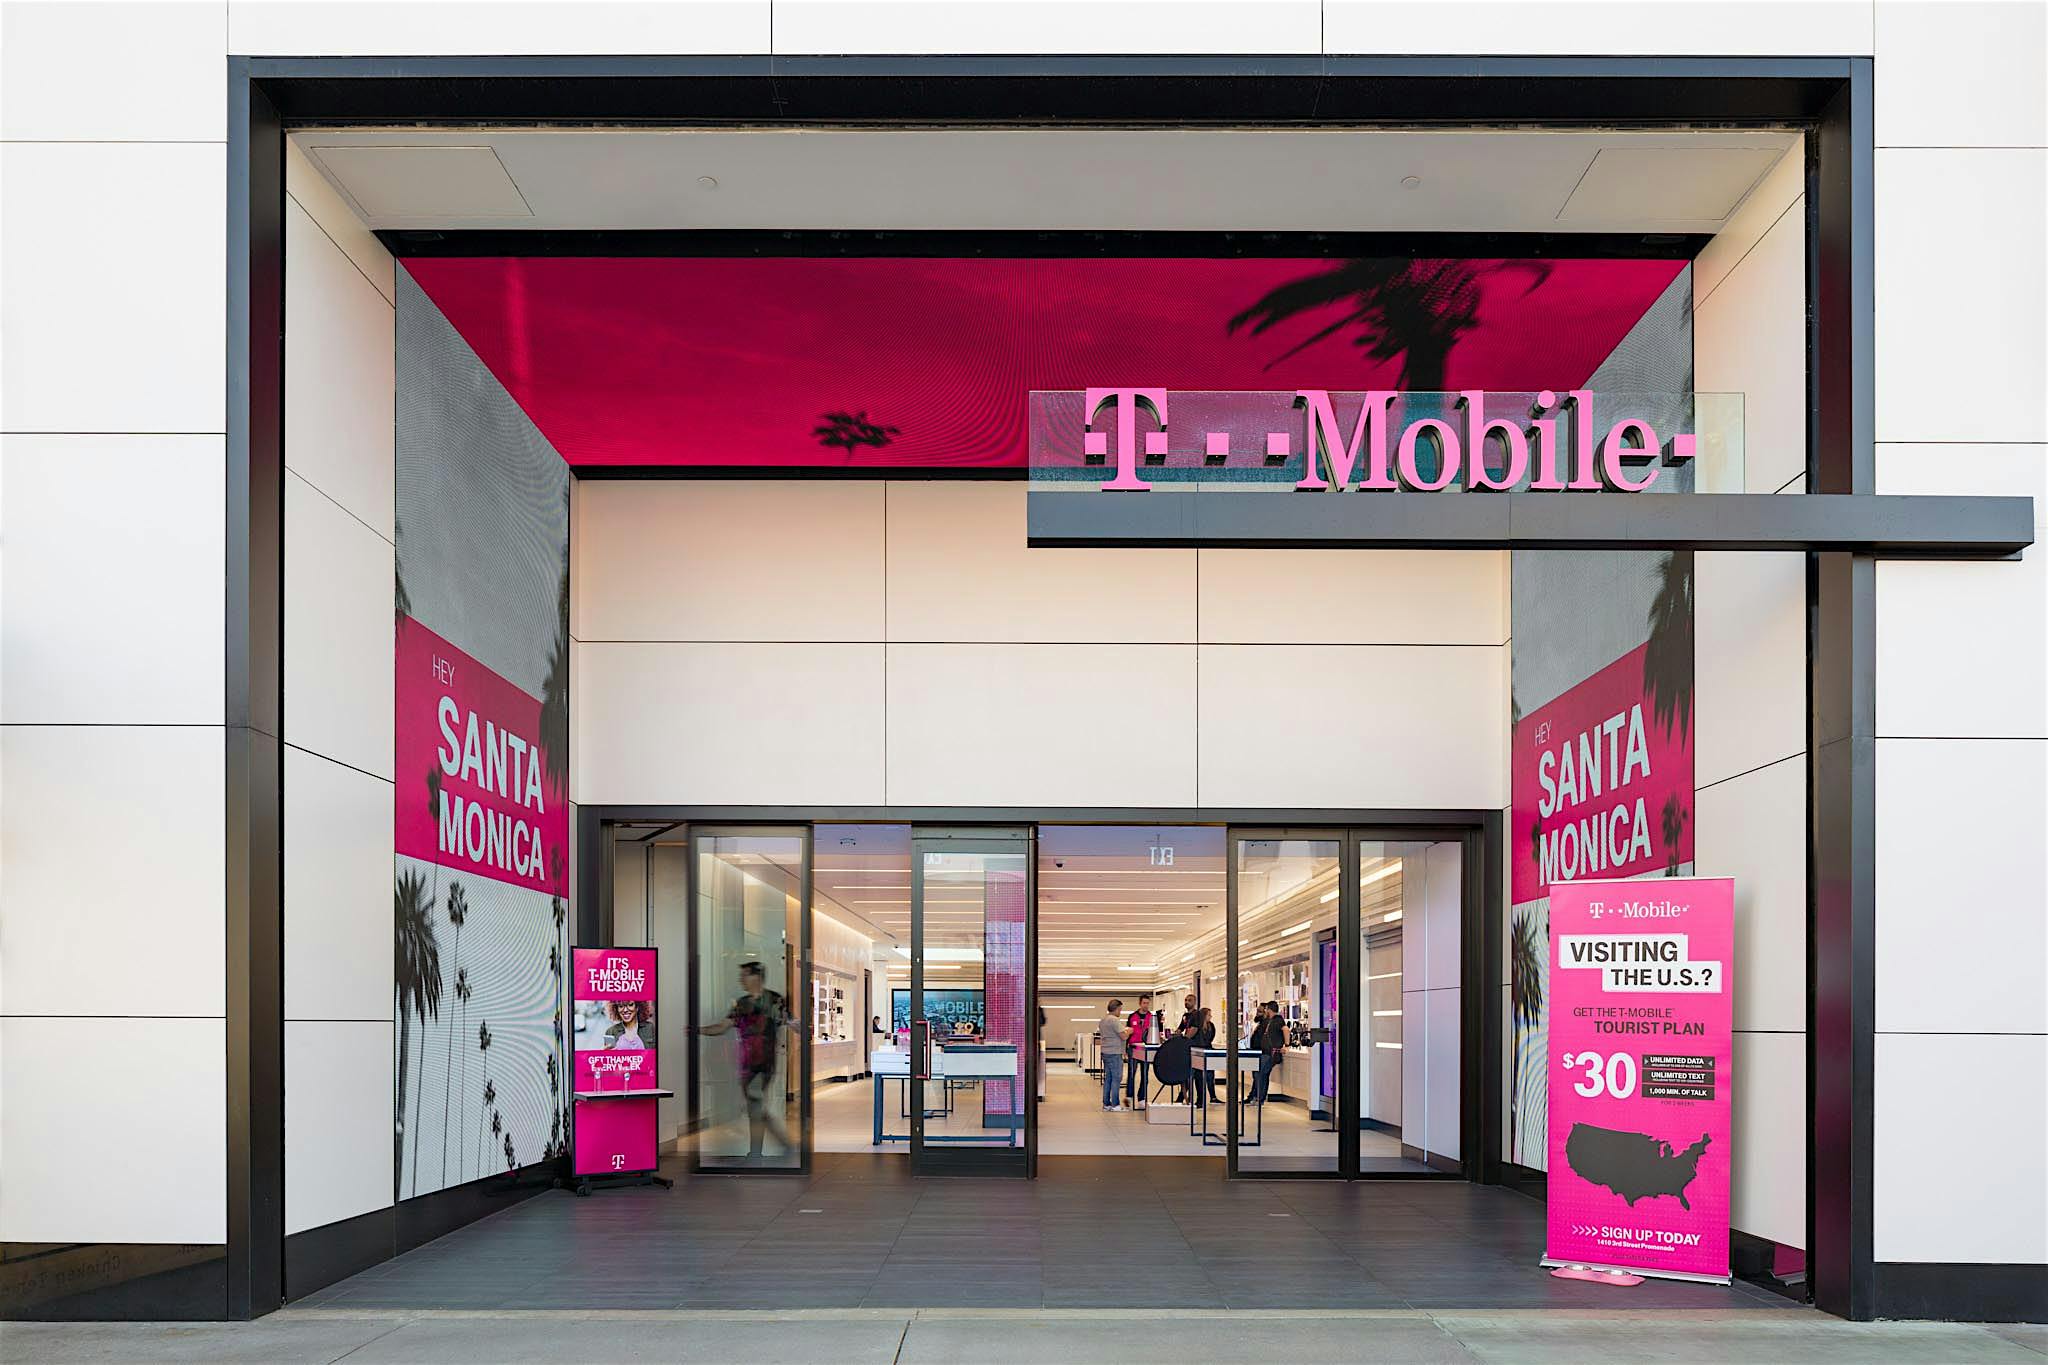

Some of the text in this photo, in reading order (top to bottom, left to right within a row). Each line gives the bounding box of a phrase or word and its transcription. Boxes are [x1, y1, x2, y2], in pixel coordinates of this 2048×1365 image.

[432, 654, 455, 687] HEY
[1535, 720, 1552, 746] HEY
[438, 695, 545, 814] SANTA
[1538, 703, 1651, 818] SANTA
[439, 789, 545, 881] MONICA
[1539, 797, 1653, 887] MONICA
[1570, 941, 1678, 962] VISITING
[588, 968, 645, 981] T-MOBILE
[1611, 968, 1713, 986] THE U.S.?
[589, 980, 645, 992] TUESDAY
[1573, 1007, 1673, 1018] GET THE T-MOBILE
[1594, 1021, 1705, 1035] TOURIST PLAN
[1562, 1051, 1637, 1100] $30
[1651, 1071, 1687, 1079] UNLIMITED
[1649, 1087, 1665, 1095] 1,000
[1691, 1089, 1707, 1097] TALK
[1601, 1226, 1701, 1246] SIGN UP TODAY
[1622, 1241, 1640, 1249] Street
[1641, 1243, 1675, 1252] Promenade
